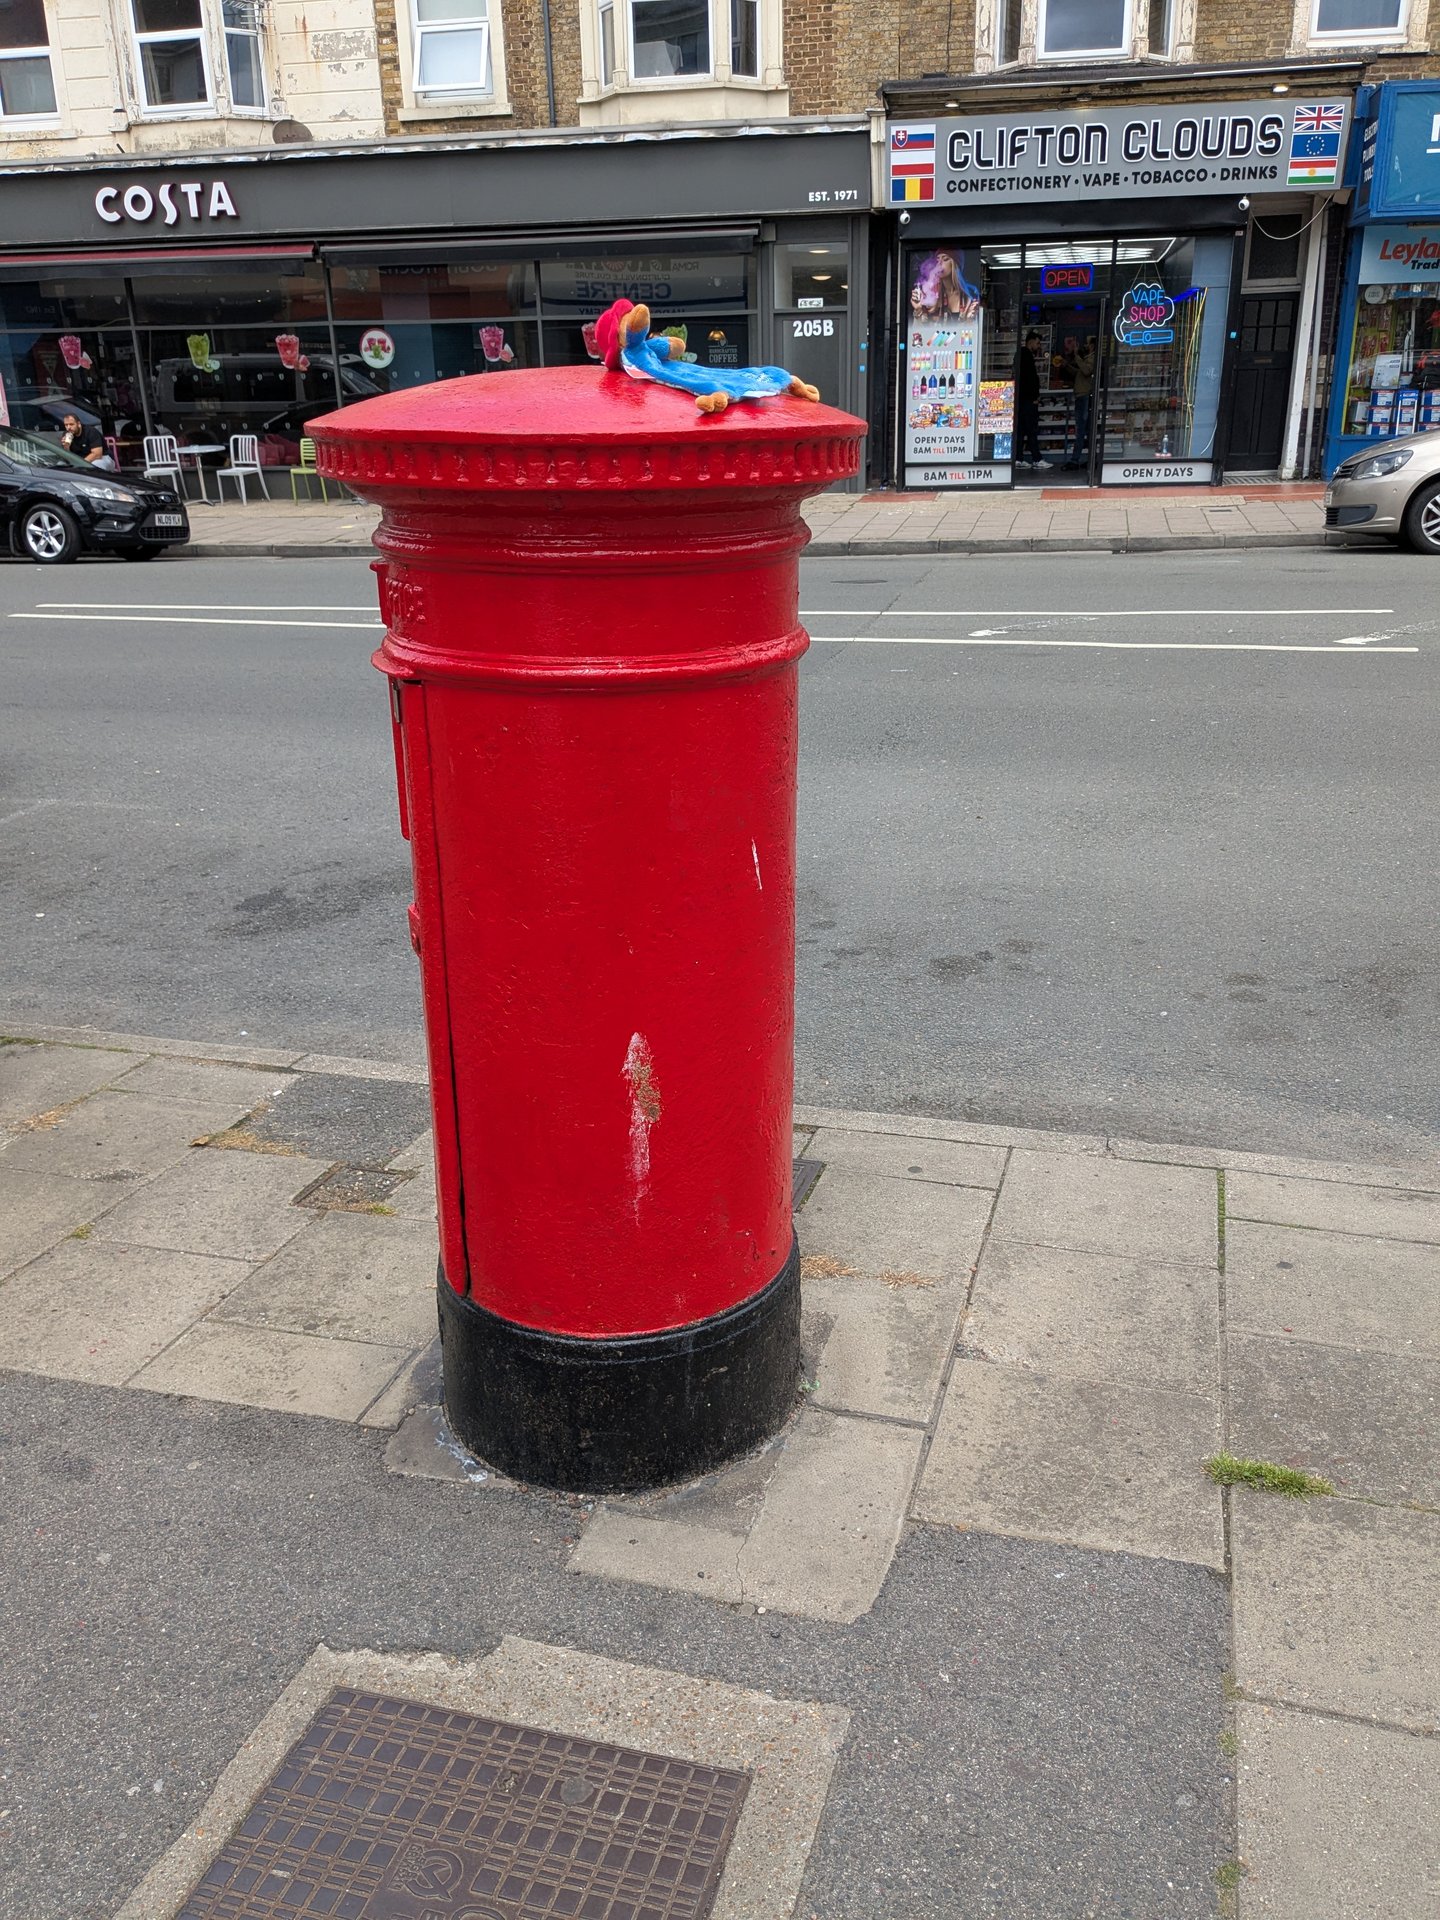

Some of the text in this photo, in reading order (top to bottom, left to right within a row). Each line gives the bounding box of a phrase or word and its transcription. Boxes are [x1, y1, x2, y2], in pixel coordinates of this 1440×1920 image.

[946, 114, 1284, 171] CLIFTON CLOUDS
[946, 166, 1278, 193] CONFECTIONERY VAPE TOBACCO DRINKS
[95, 181, 239, 226] COSTA
[808, 190, 857, 202] EST. 1971
[1379, 237, 1440, 265] Leyla
[1045, 270, 1090, 287] OPEN
[1131, 289, 1165, 305] VAPE
[1130, 306, 1165, 322] SHOP
[792, 319, 834, 338] 205B
[709, 354, 738, 363] COFFEE
[914, 435, 965, 444] OPEN 7 DAYS
[946, 446, 966, 454] 11PM
[923, 469, 993, 481] 8AM TILL 11PM
[1122, 467, 1193, 478] OPEN 7 DAYS
